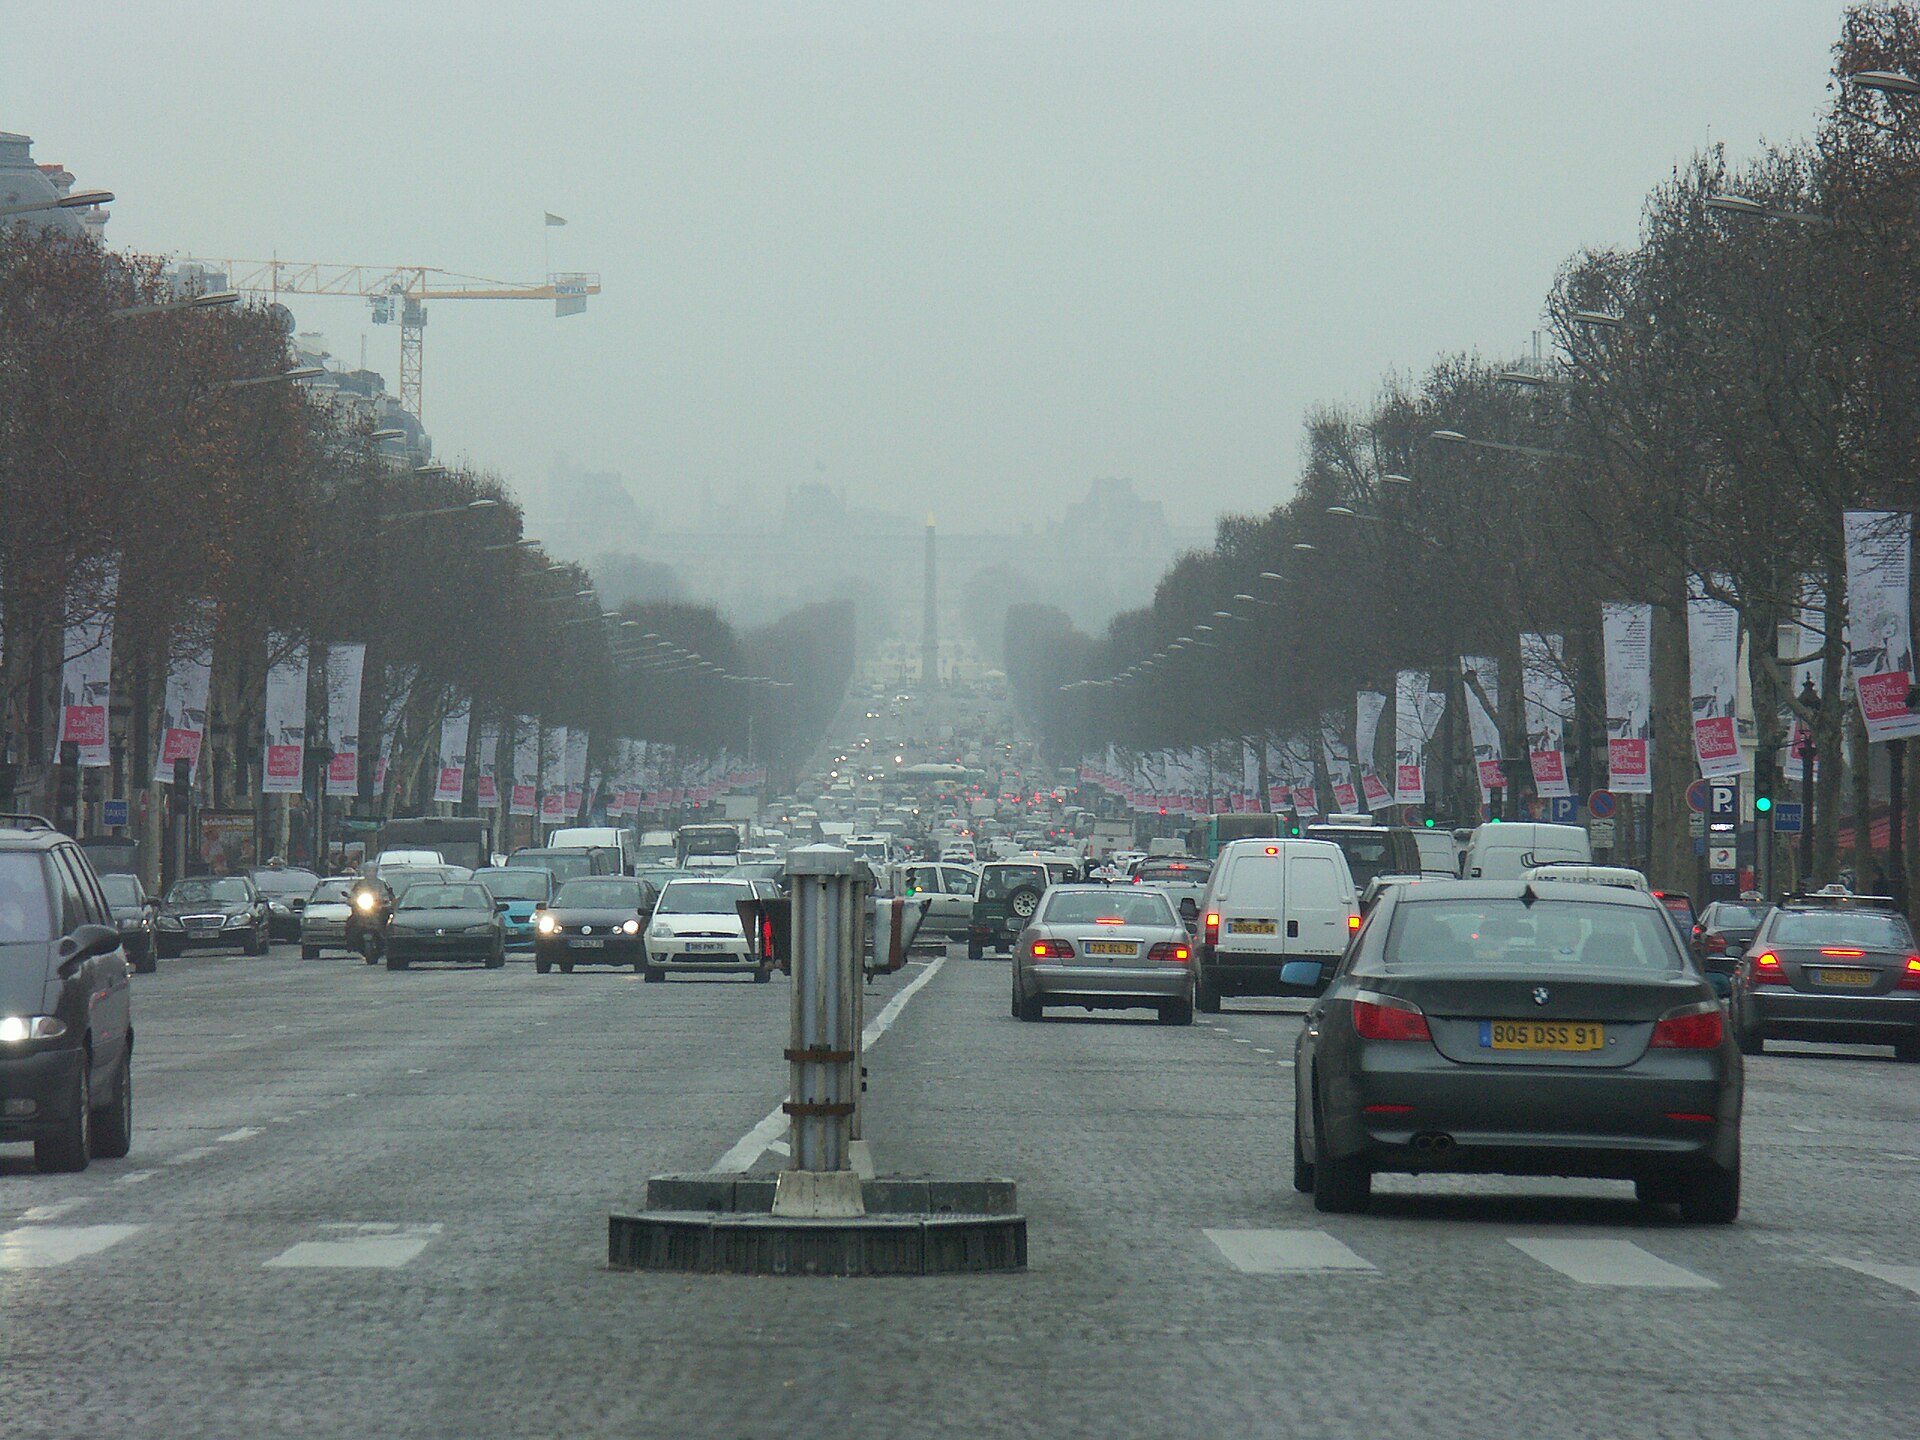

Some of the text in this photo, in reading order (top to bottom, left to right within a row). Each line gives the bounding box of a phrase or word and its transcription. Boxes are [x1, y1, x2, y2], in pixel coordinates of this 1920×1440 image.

[1862, 687, 1904, 698] CAPITALE
[1559, 800, 1572, 818] P
[1713, 788, 1732, 812] P
[1777, 813, 1801, 822] TAXIS
[1494, 1026, 1598, 1044] 805 DSS 91
